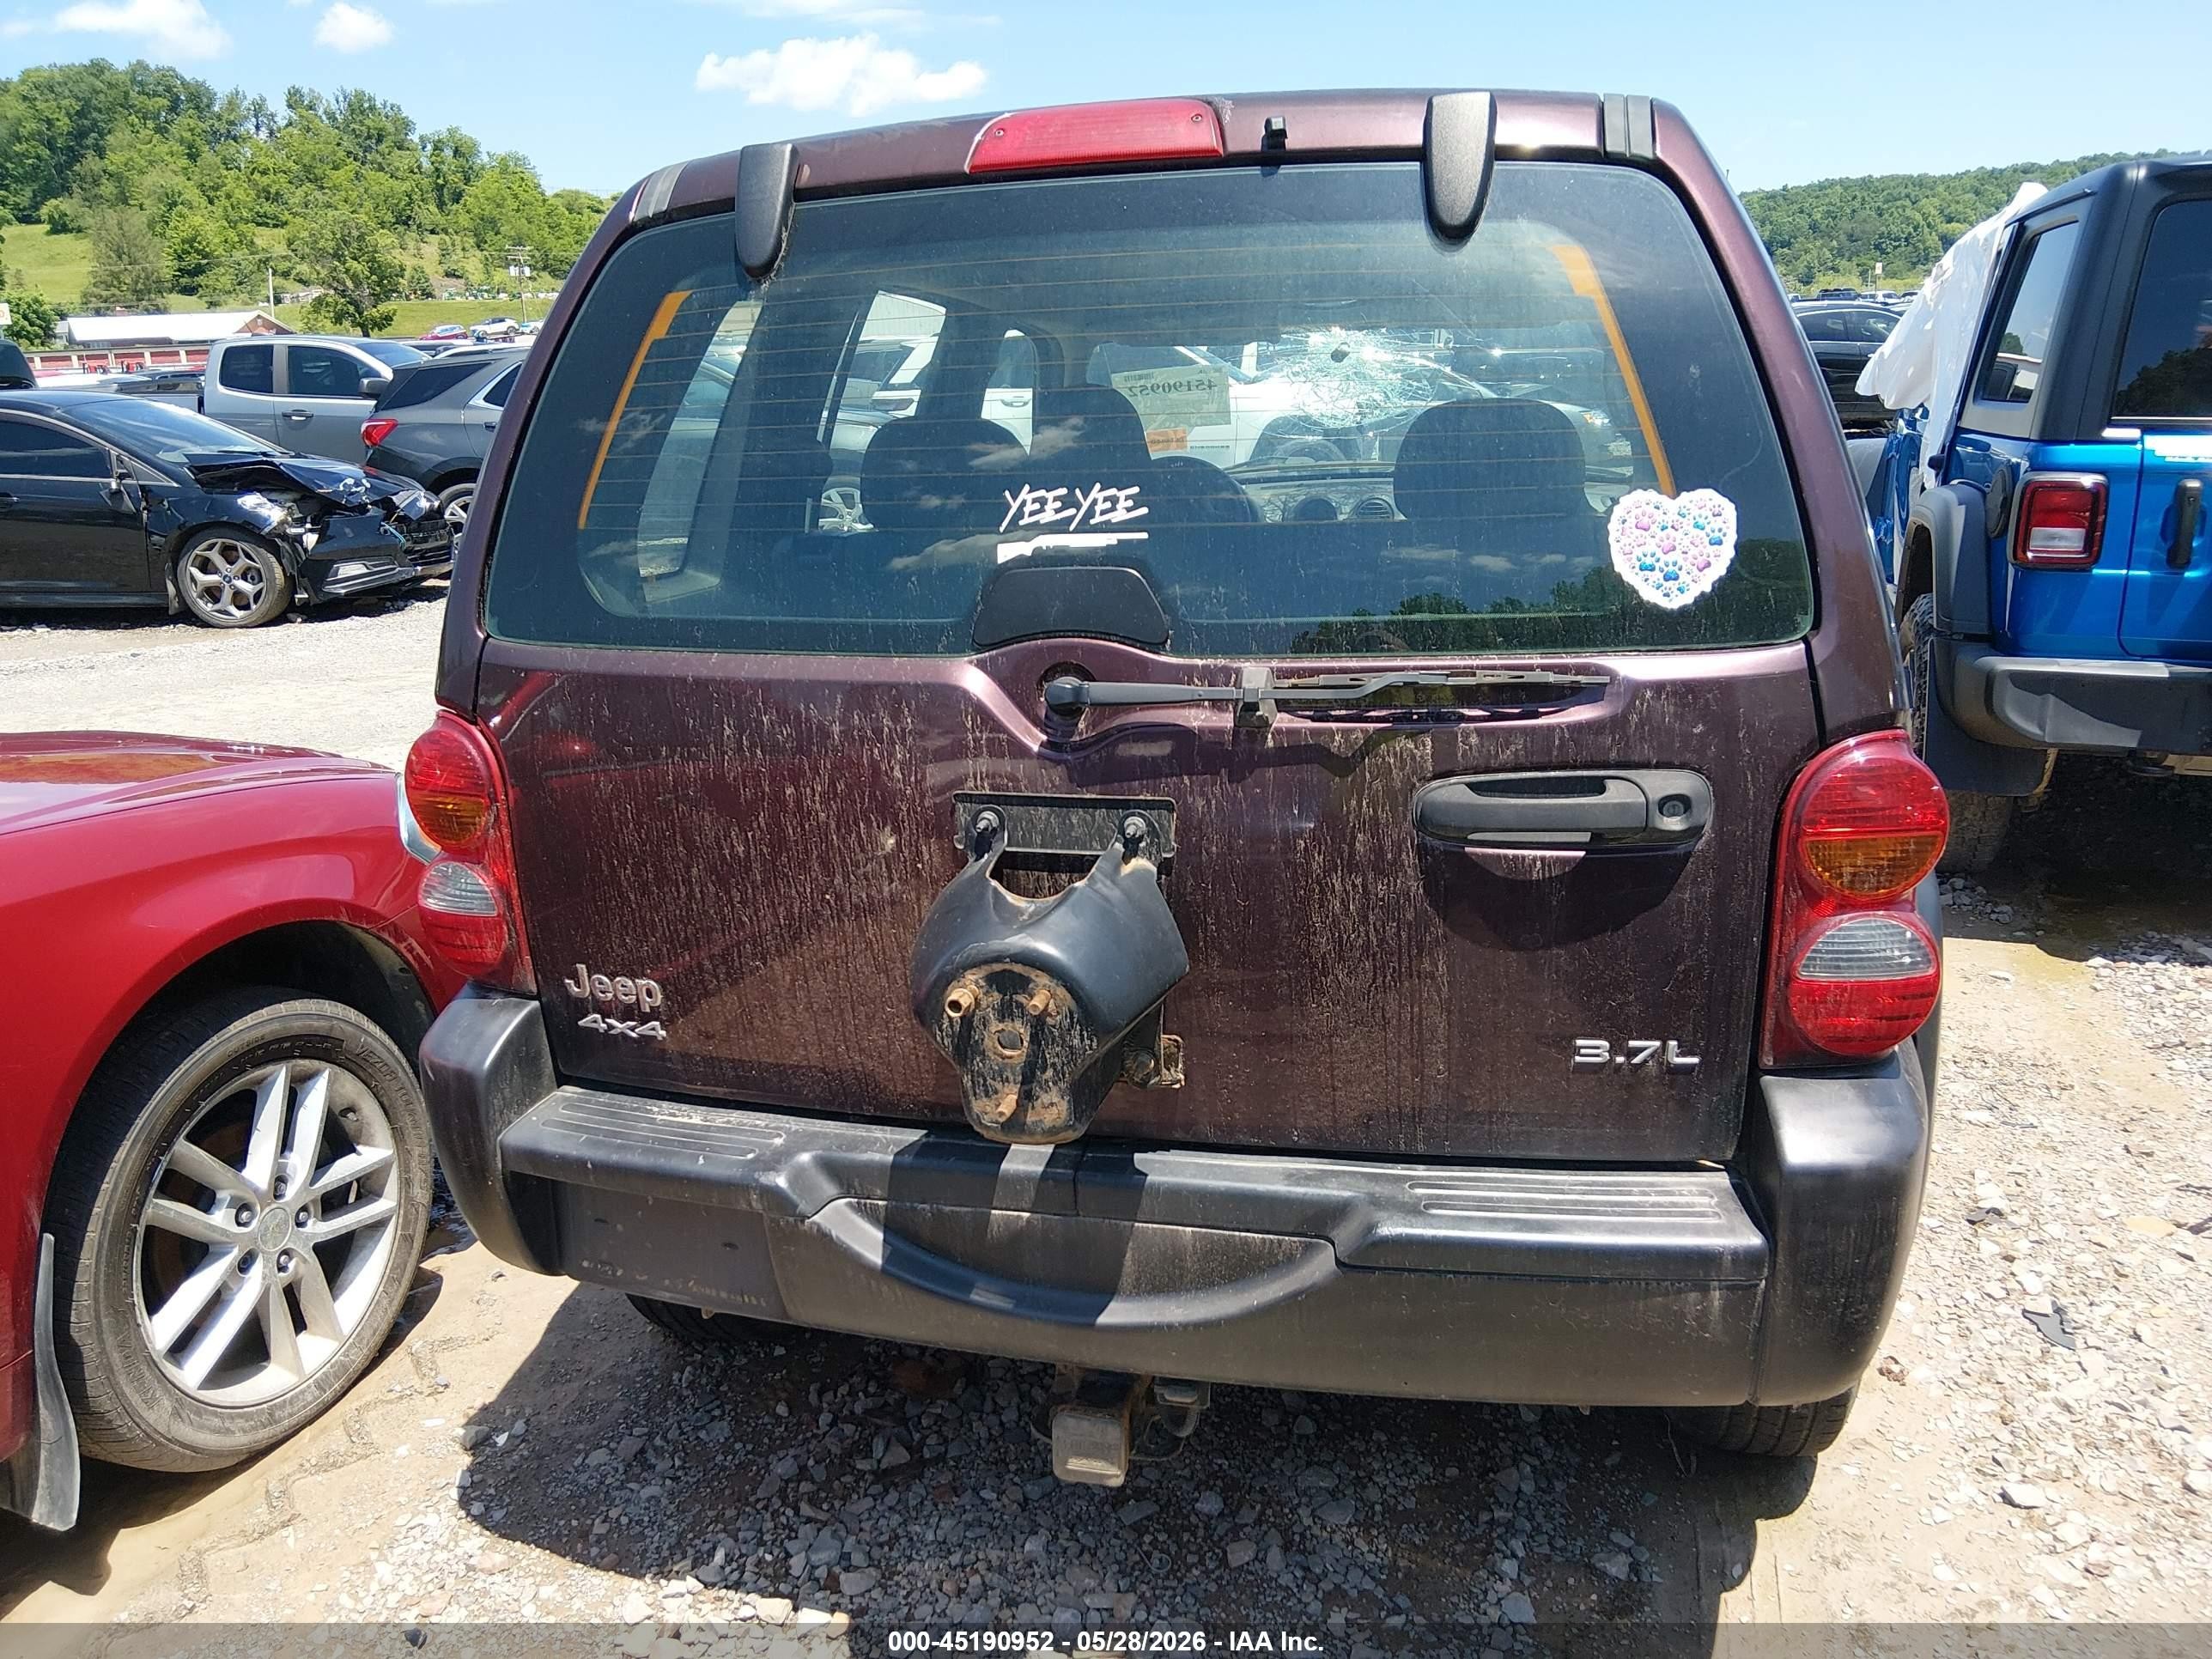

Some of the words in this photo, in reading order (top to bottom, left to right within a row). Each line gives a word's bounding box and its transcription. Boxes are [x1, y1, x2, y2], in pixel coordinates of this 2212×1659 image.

[563, 963, 663, 1012] Jeep
[226, 1034, 267, 1059] OUTSIDE
[1573, 1038, 1701, 1065] 3.7L
[117, 1330, 166, 1410] KENDA
